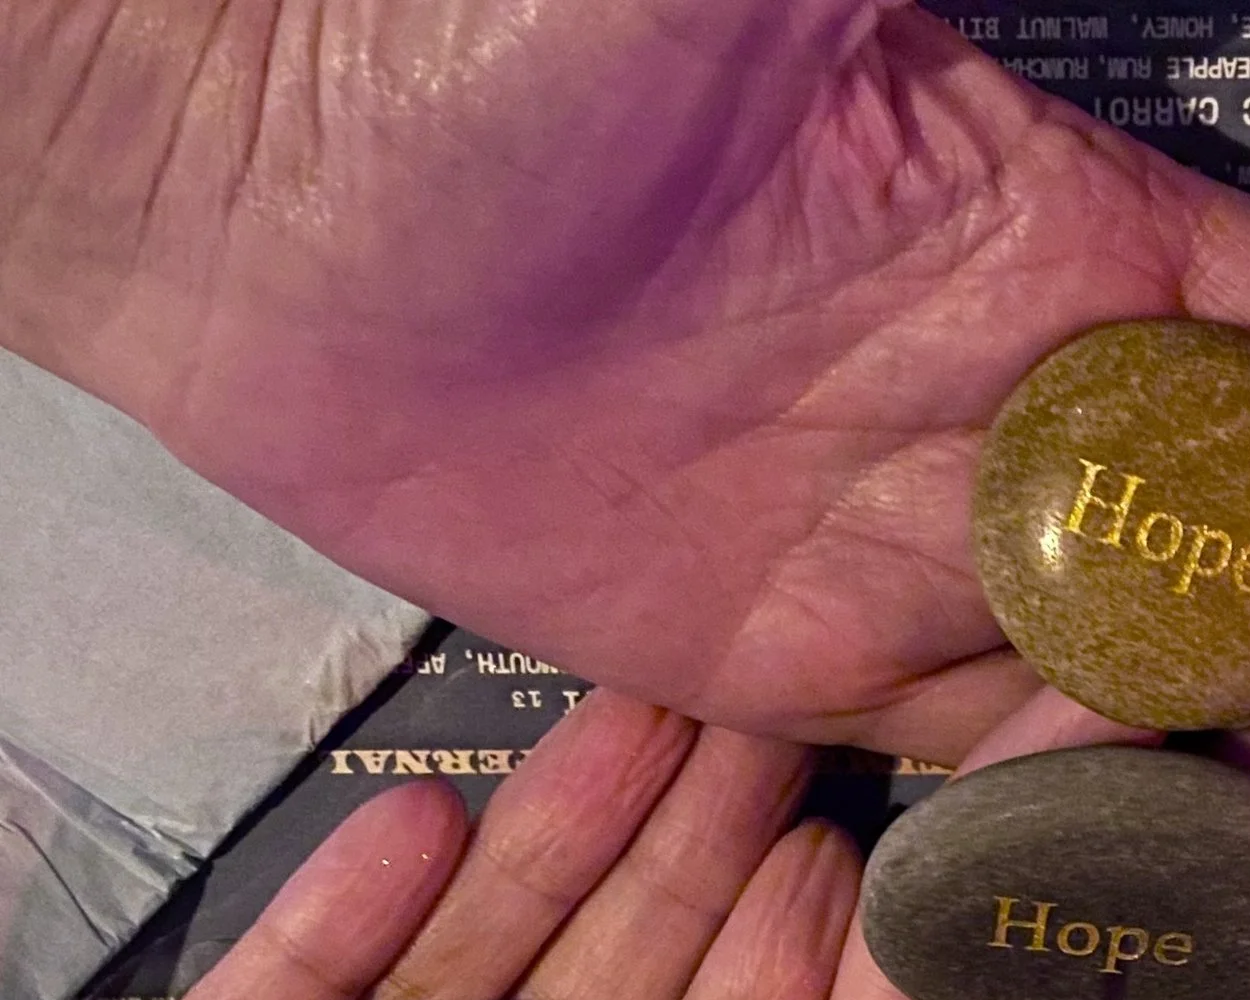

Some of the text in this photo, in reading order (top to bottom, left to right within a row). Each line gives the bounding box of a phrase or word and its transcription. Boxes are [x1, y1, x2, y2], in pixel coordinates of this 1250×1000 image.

[944, 16, 1000, 40] BIT
[1016, 16, 1109, 40] WALNUT
[1131, 13, 1215, 39] HONEY,
[1098, 54, 1152, 80] RUM,
[510, 690, 543, 709] 13
[987, 896, 1195, 974] Hope
